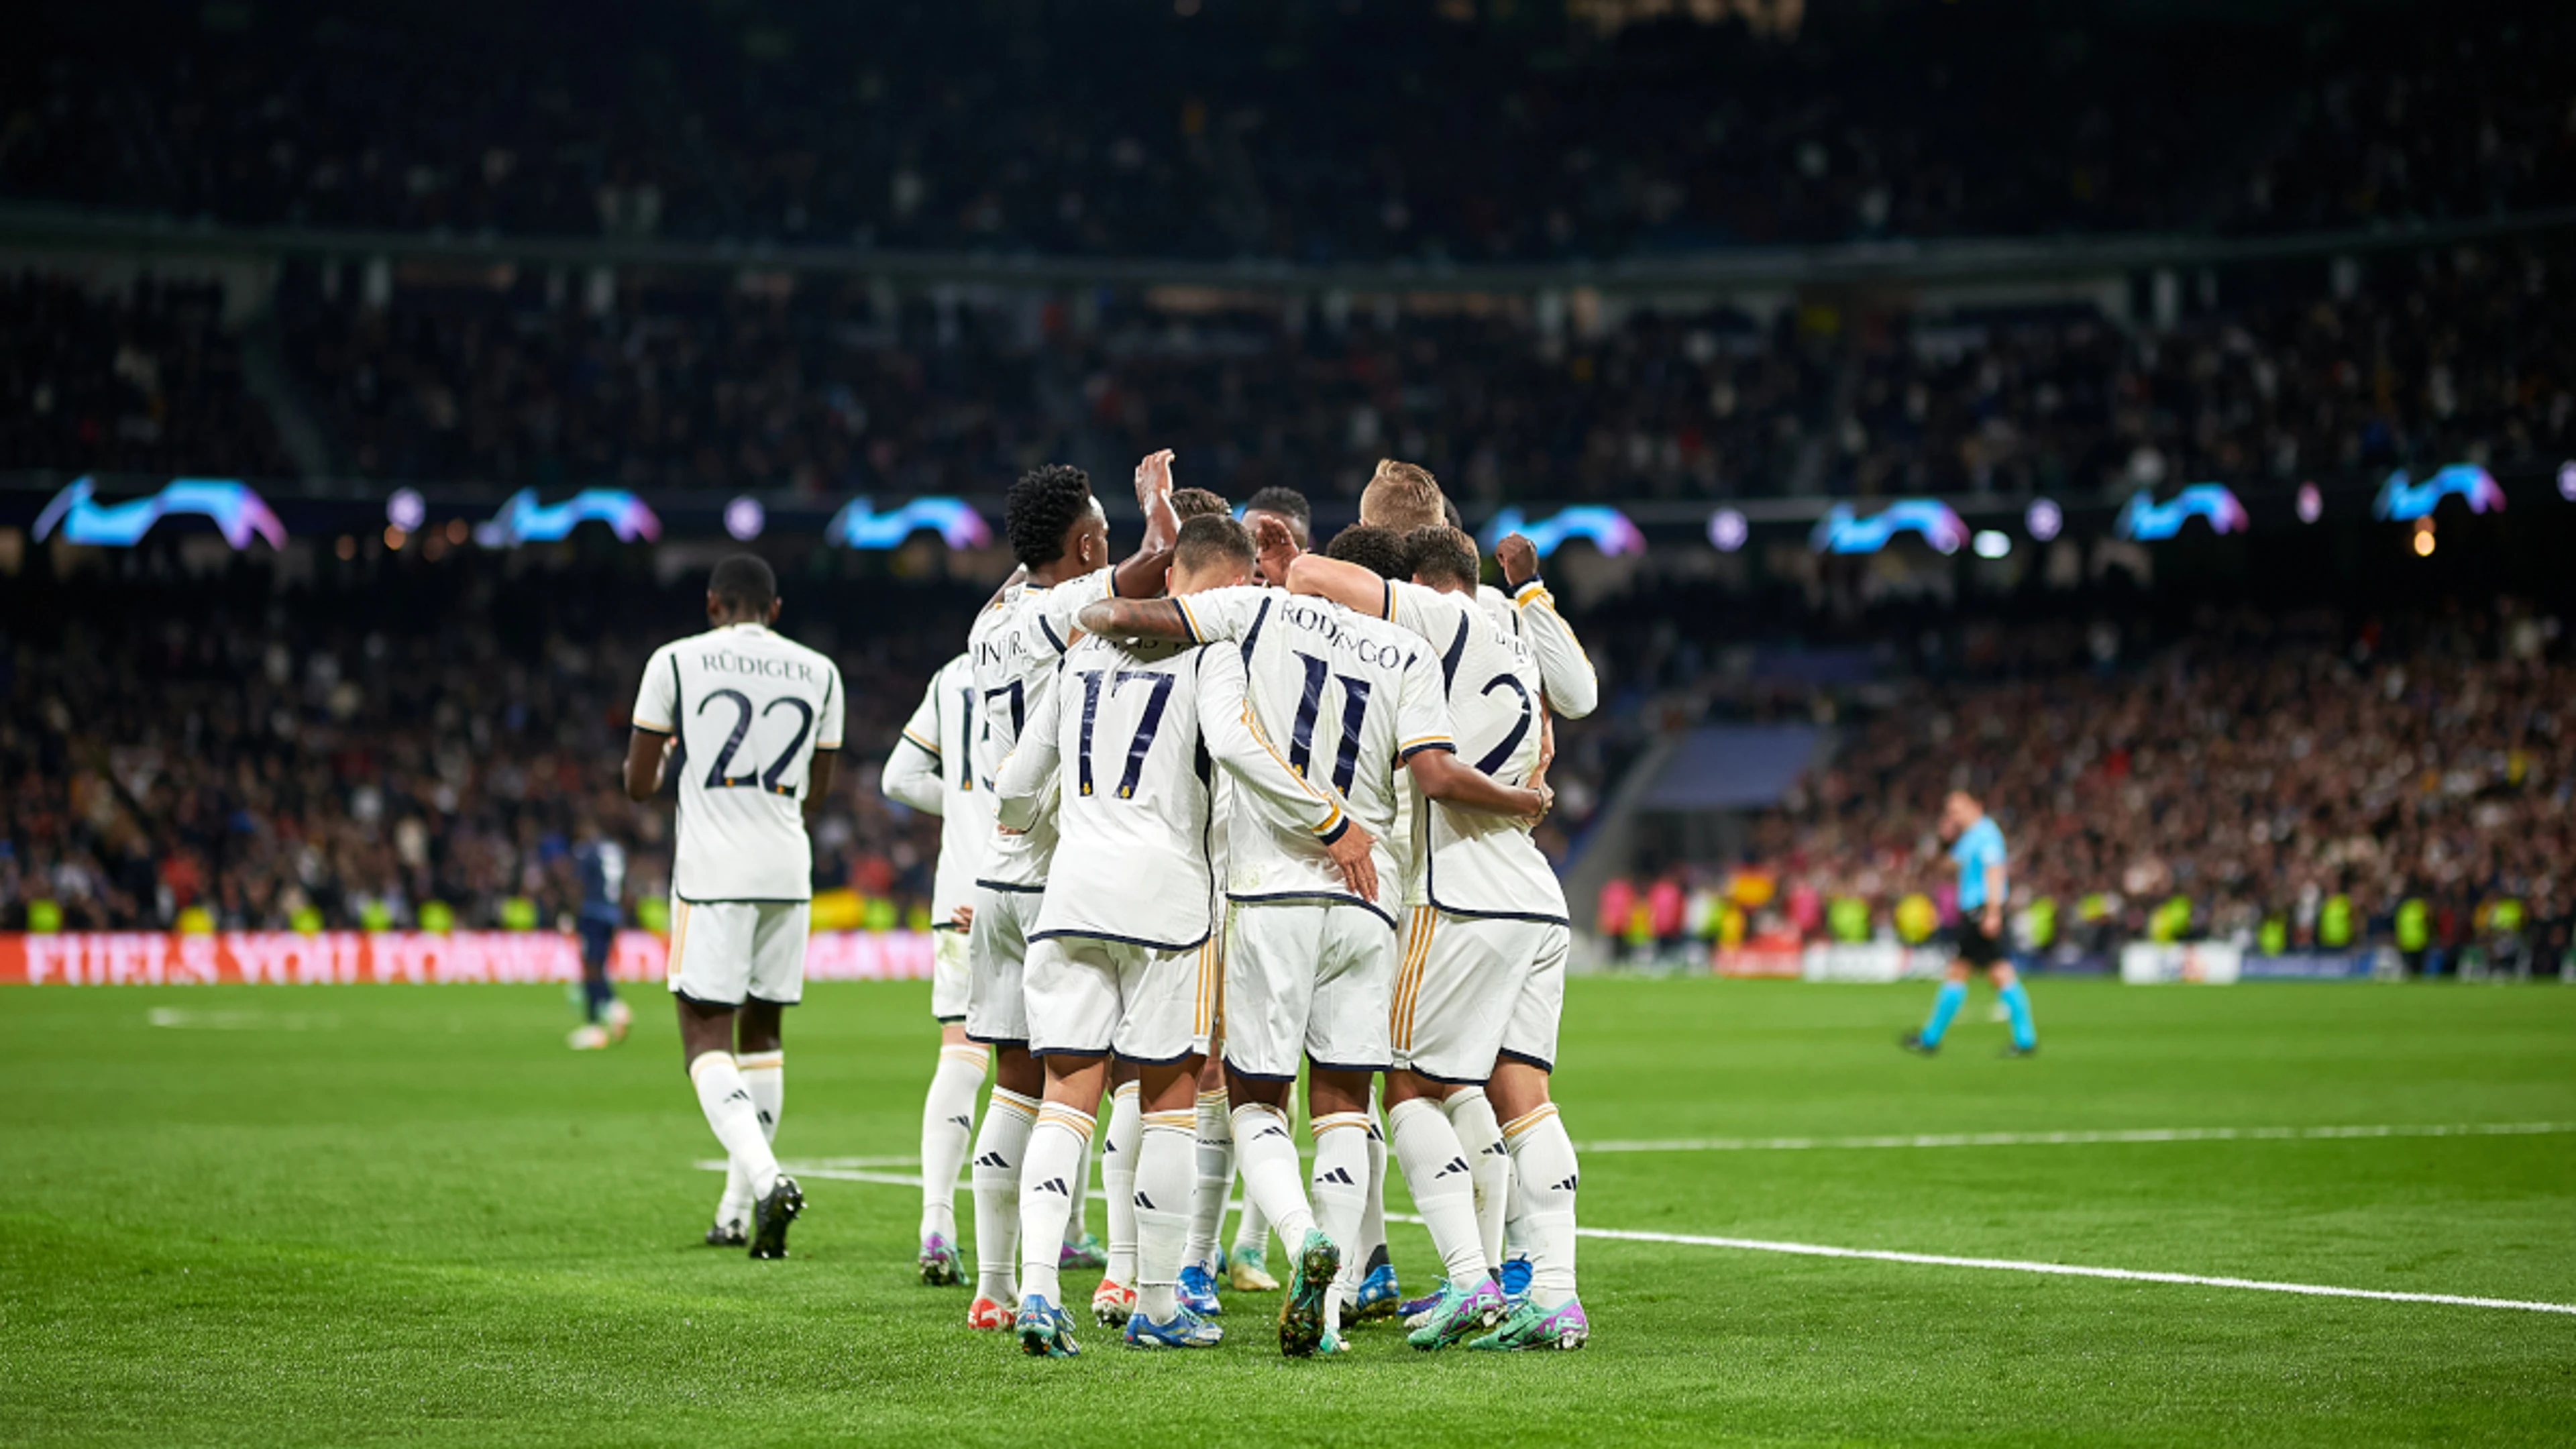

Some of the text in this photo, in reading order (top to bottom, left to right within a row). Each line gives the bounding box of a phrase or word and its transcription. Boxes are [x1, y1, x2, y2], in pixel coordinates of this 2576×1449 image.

[702, 649, 814, 684] RÜDIGER
[696, 688, 814, 798] 22
[1075, 669, 1176, 799] 17
[1289, 649, 1372, 800] 11
[23, 932, 219, 986] FUELS
[227, 931, 360, 986] YOU
